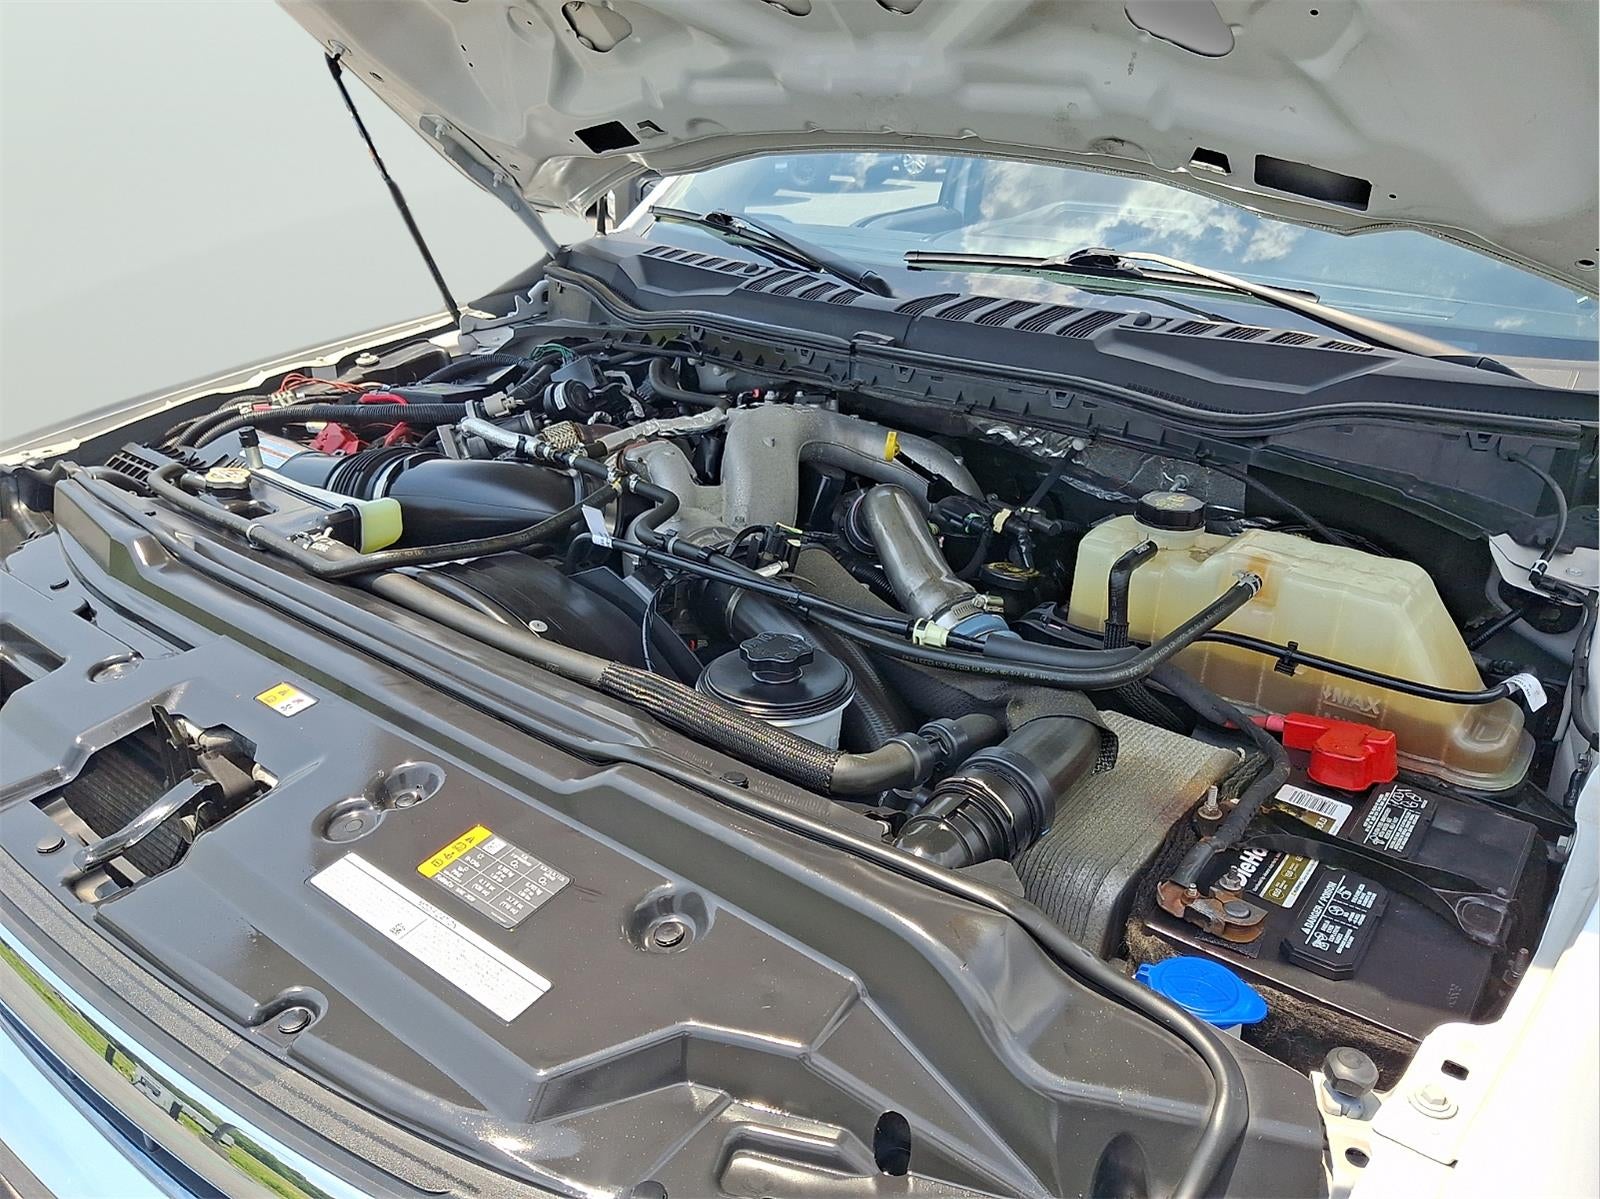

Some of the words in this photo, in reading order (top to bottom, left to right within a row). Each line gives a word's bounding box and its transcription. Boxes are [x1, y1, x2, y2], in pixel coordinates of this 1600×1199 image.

[1332, 687, 1380, 714] MAX
[1304, 904, 1324, 930] DANGER
[1319, 881, 1337, 902] POISON
